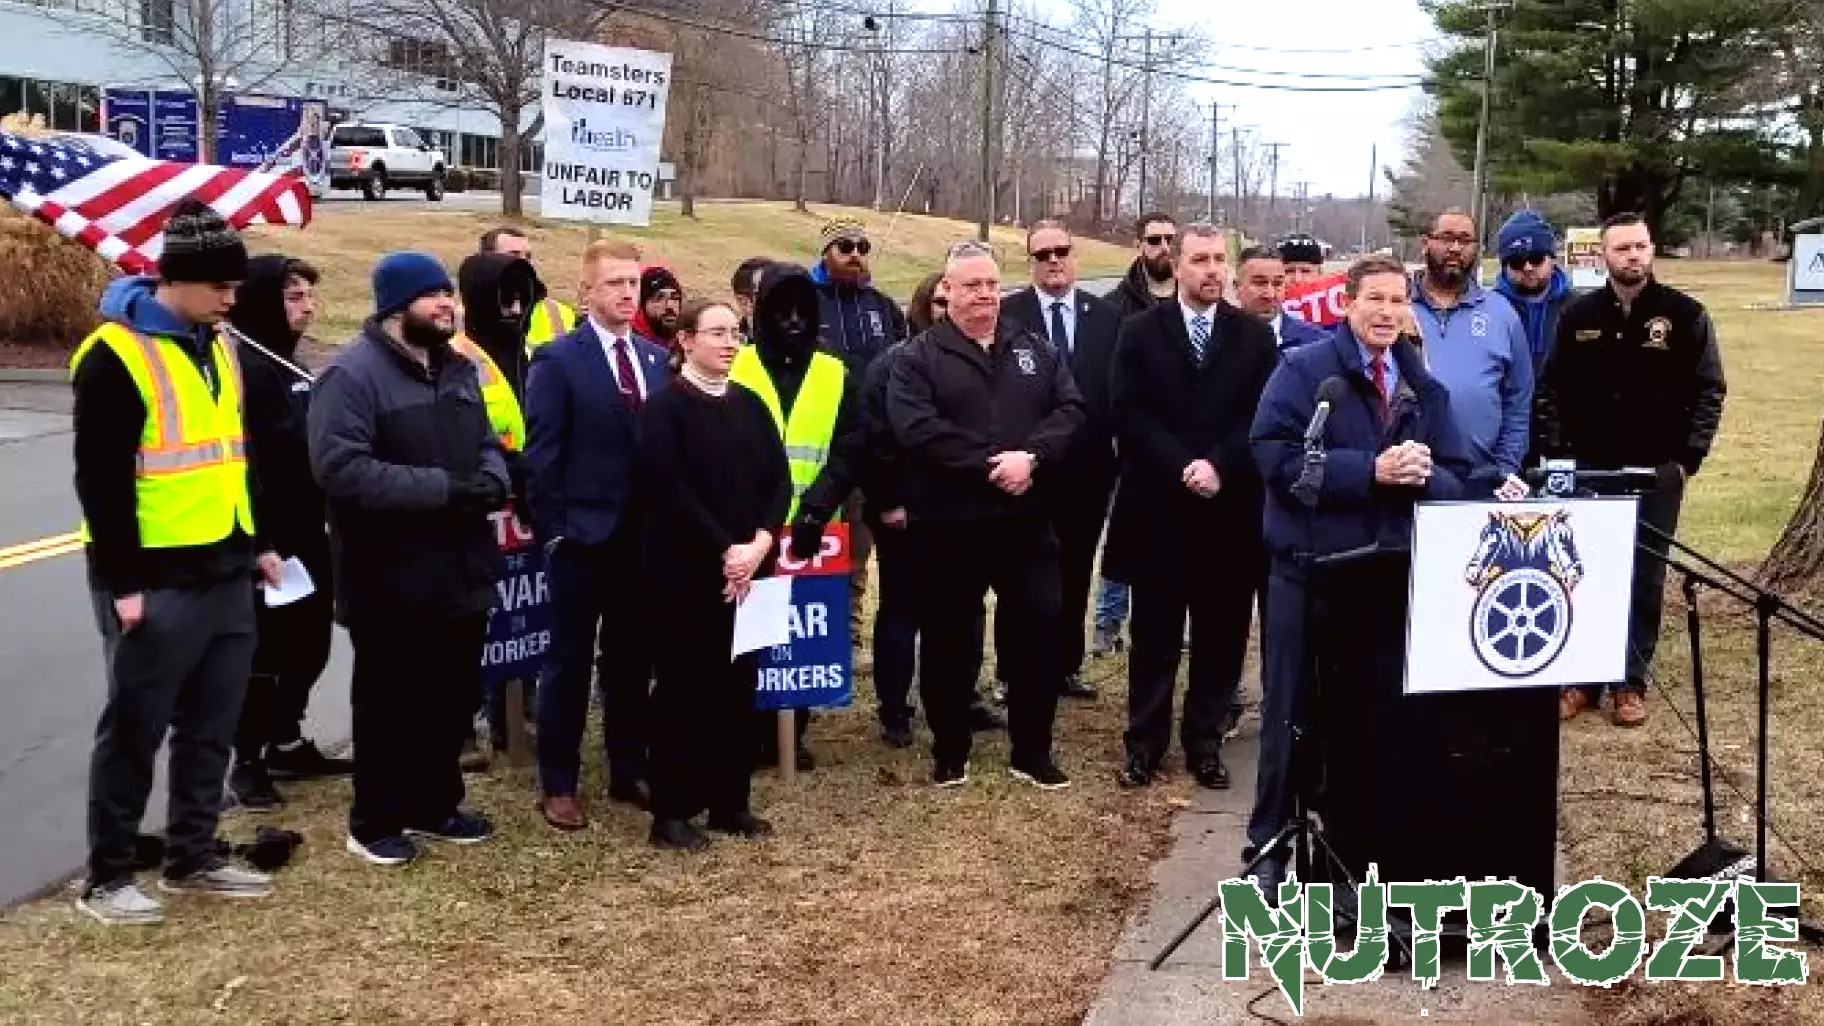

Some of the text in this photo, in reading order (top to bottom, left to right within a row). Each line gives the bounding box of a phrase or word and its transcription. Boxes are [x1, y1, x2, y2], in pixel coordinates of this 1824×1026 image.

[550, 52, 666, 86] Teamsters
[553, 80, 614, 104] Local
[546, 162, 653, 190] UNFAIR TO
[563, 187, 634, 210] LABOR
[1281, 283, 1346, 323] STO
[786, 602, 828, 639] AR
[480, 629, 551, 667] ORKER
